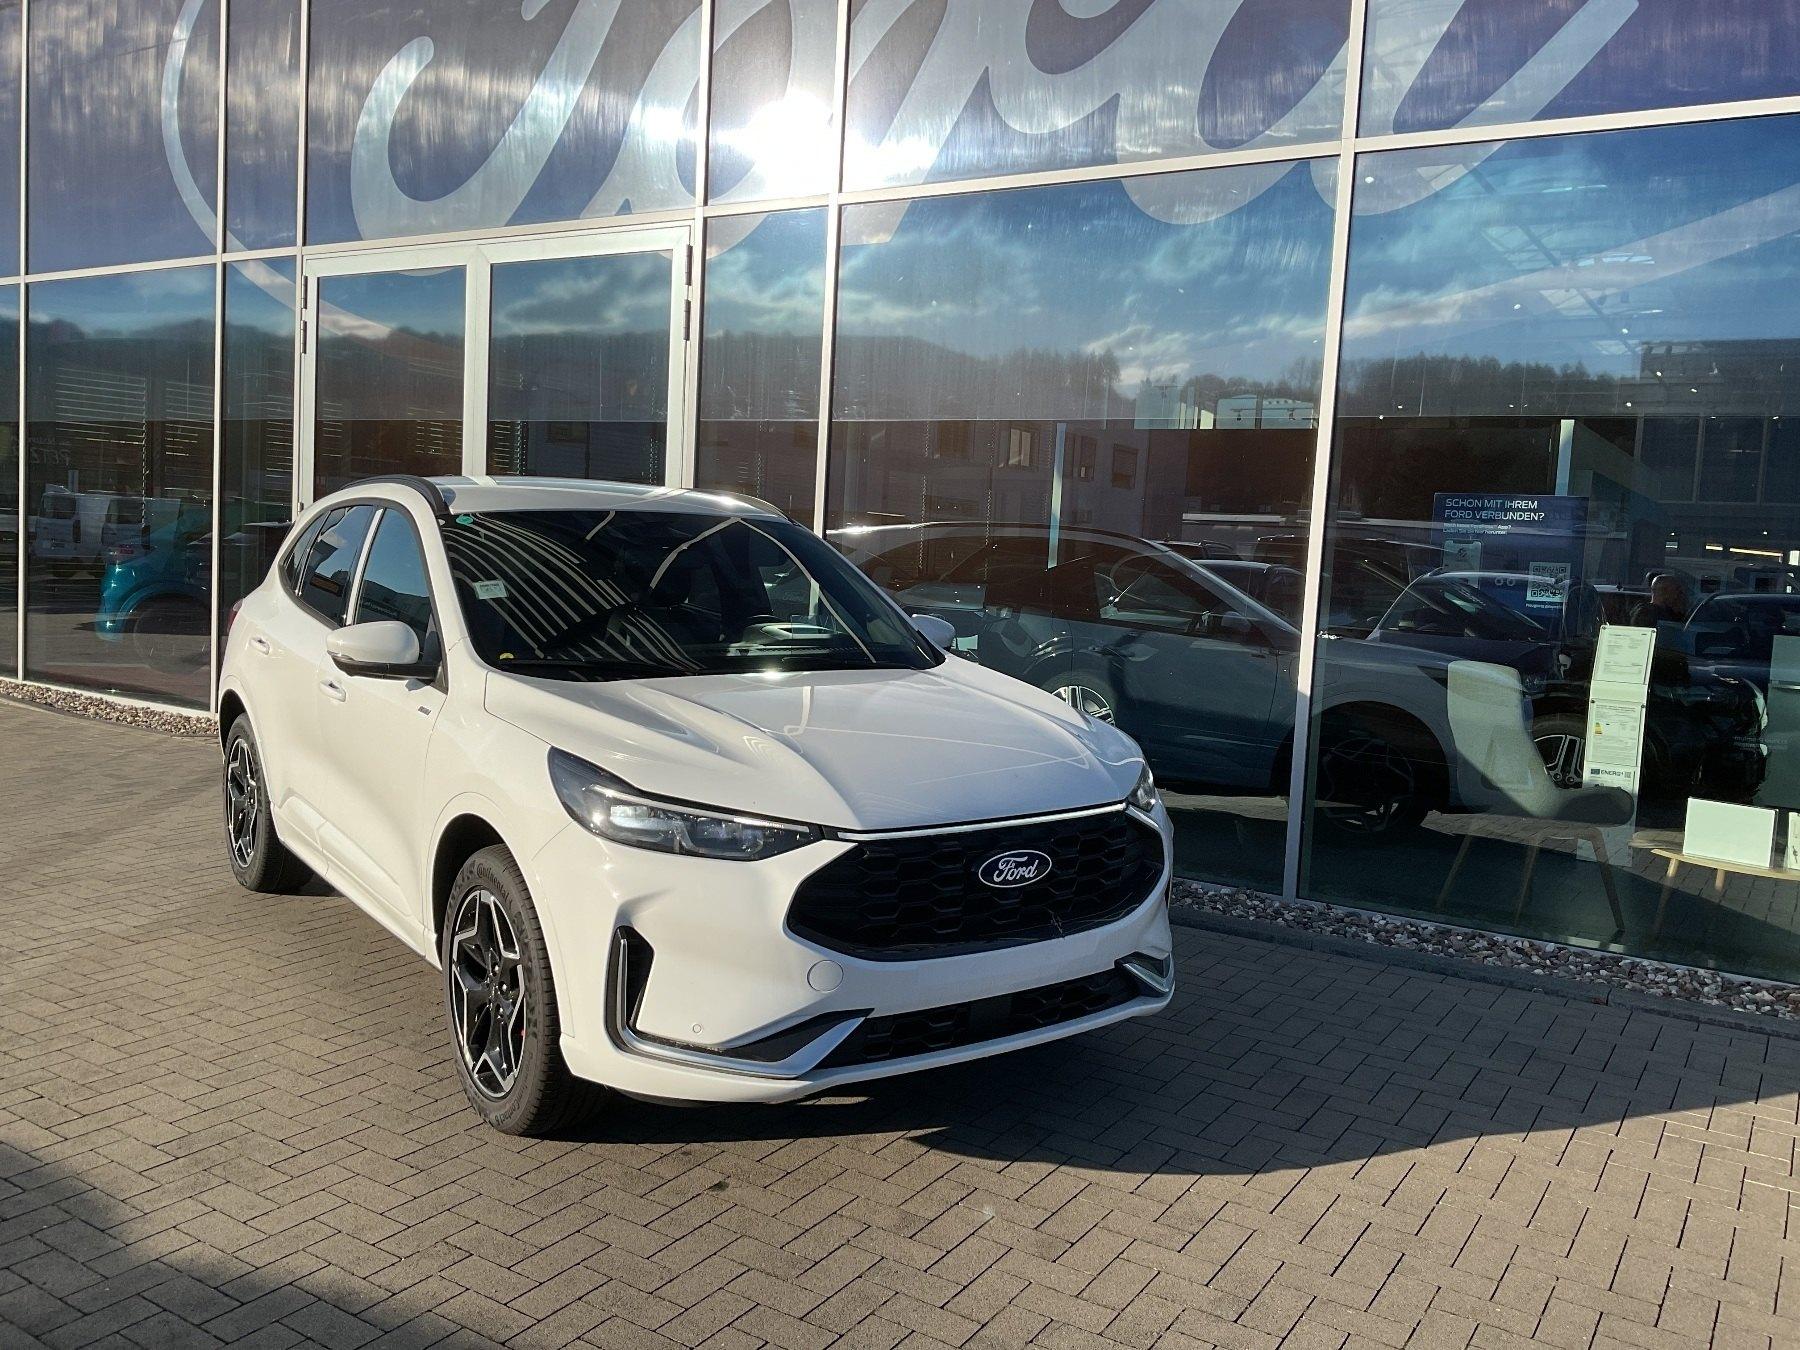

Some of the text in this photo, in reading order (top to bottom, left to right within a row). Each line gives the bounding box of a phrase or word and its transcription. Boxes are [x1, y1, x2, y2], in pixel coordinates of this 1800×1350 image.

[1445, 498, 1538, 509] SCHON MIT IHREM
[1444, 509, 1545, 521] FORD VERBUNDEN?
[993, 856, 1039, 883] Ford
[477, 863, 510, 903] Continental
